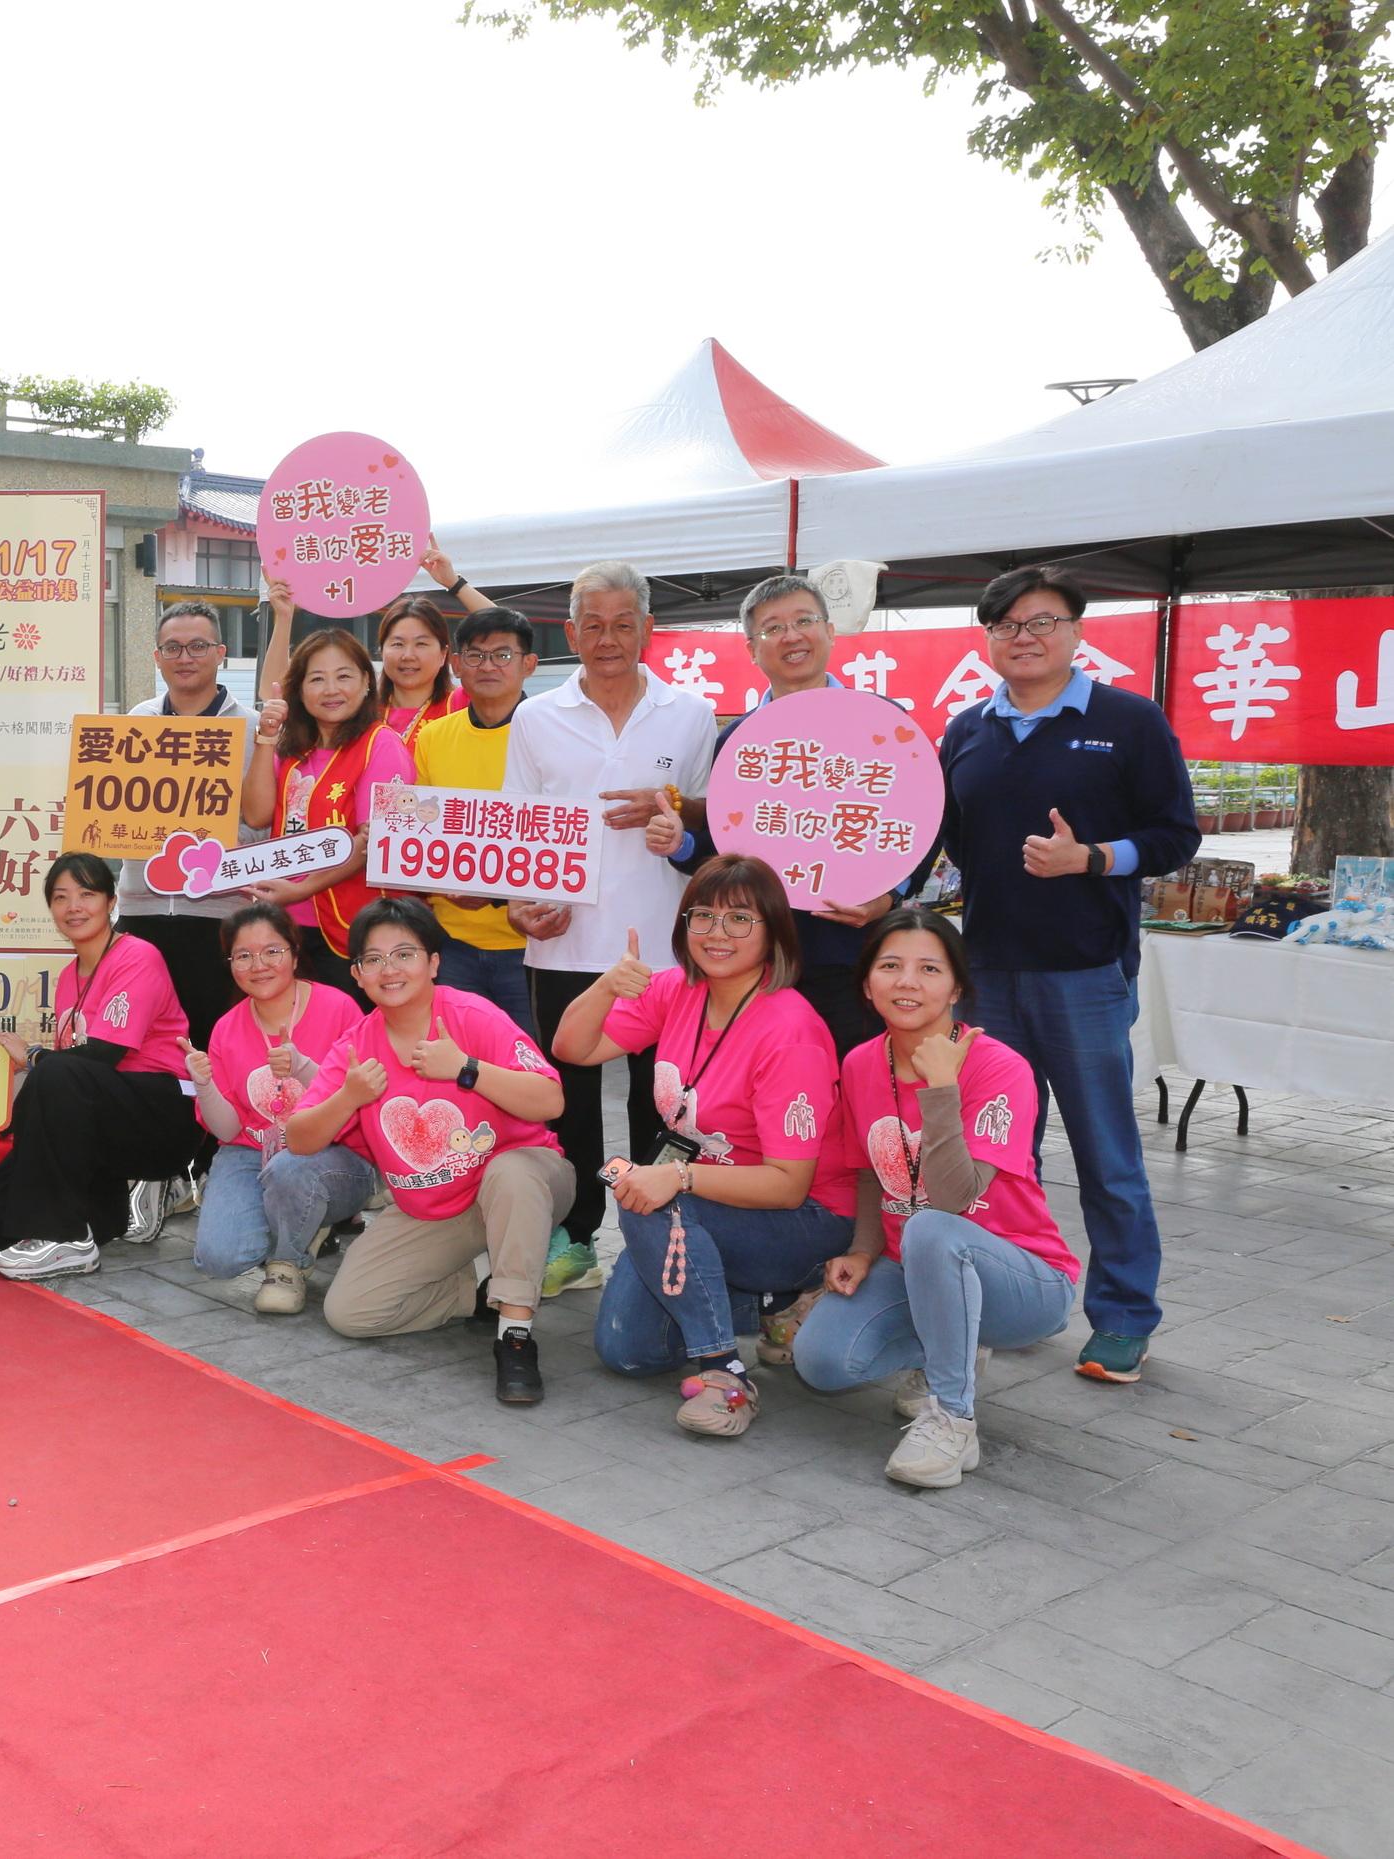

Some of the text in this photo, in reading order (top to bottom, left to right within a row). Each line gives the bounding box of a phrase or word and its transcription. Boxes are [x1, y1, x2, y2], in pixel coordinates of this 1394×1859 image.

[270, 479, 391, 524] 當我變老
[293, 522, 414, 567] 請你愛我
[323, 575, 357, 605] +1
[77, 727, 234, 768] 愛心年菜
[735, 738, 897, 798] 當我變老
[73, 774, 234, 818] 1000/份
[383, 810, 433, 836] 愛老人
[442, 797, 591, 846] 劃撥帳號
[752, 802, 916, 856] 請你愛我
[220, 836, 341, 881] 華山基金會
[376, 835, 587, 894] 19960885
[783, 862, 826, 896] +1
